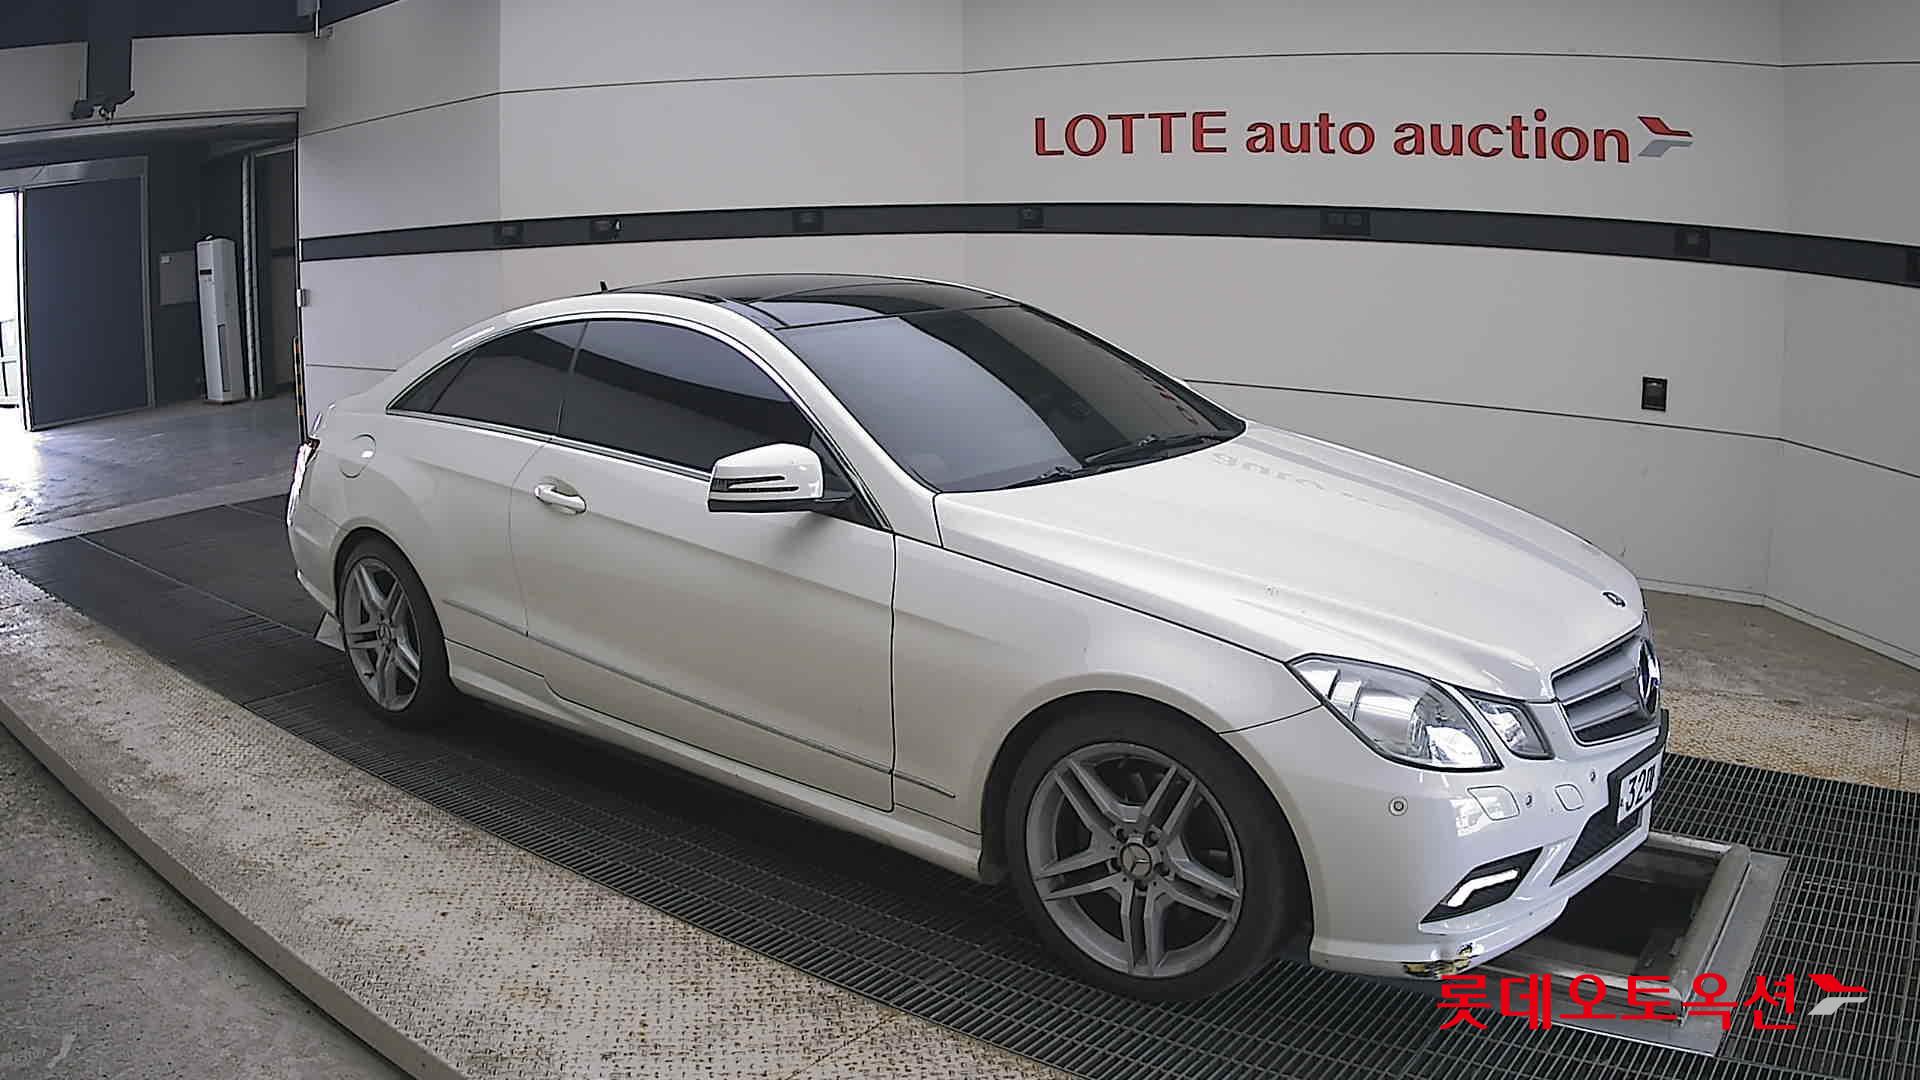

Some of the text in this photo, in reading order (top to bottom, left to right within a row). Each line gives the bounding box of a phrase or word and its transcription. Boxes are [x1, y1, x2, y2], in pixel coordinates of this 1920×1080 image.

[1034, 109, 1631, 163] LOTTE auto auction
